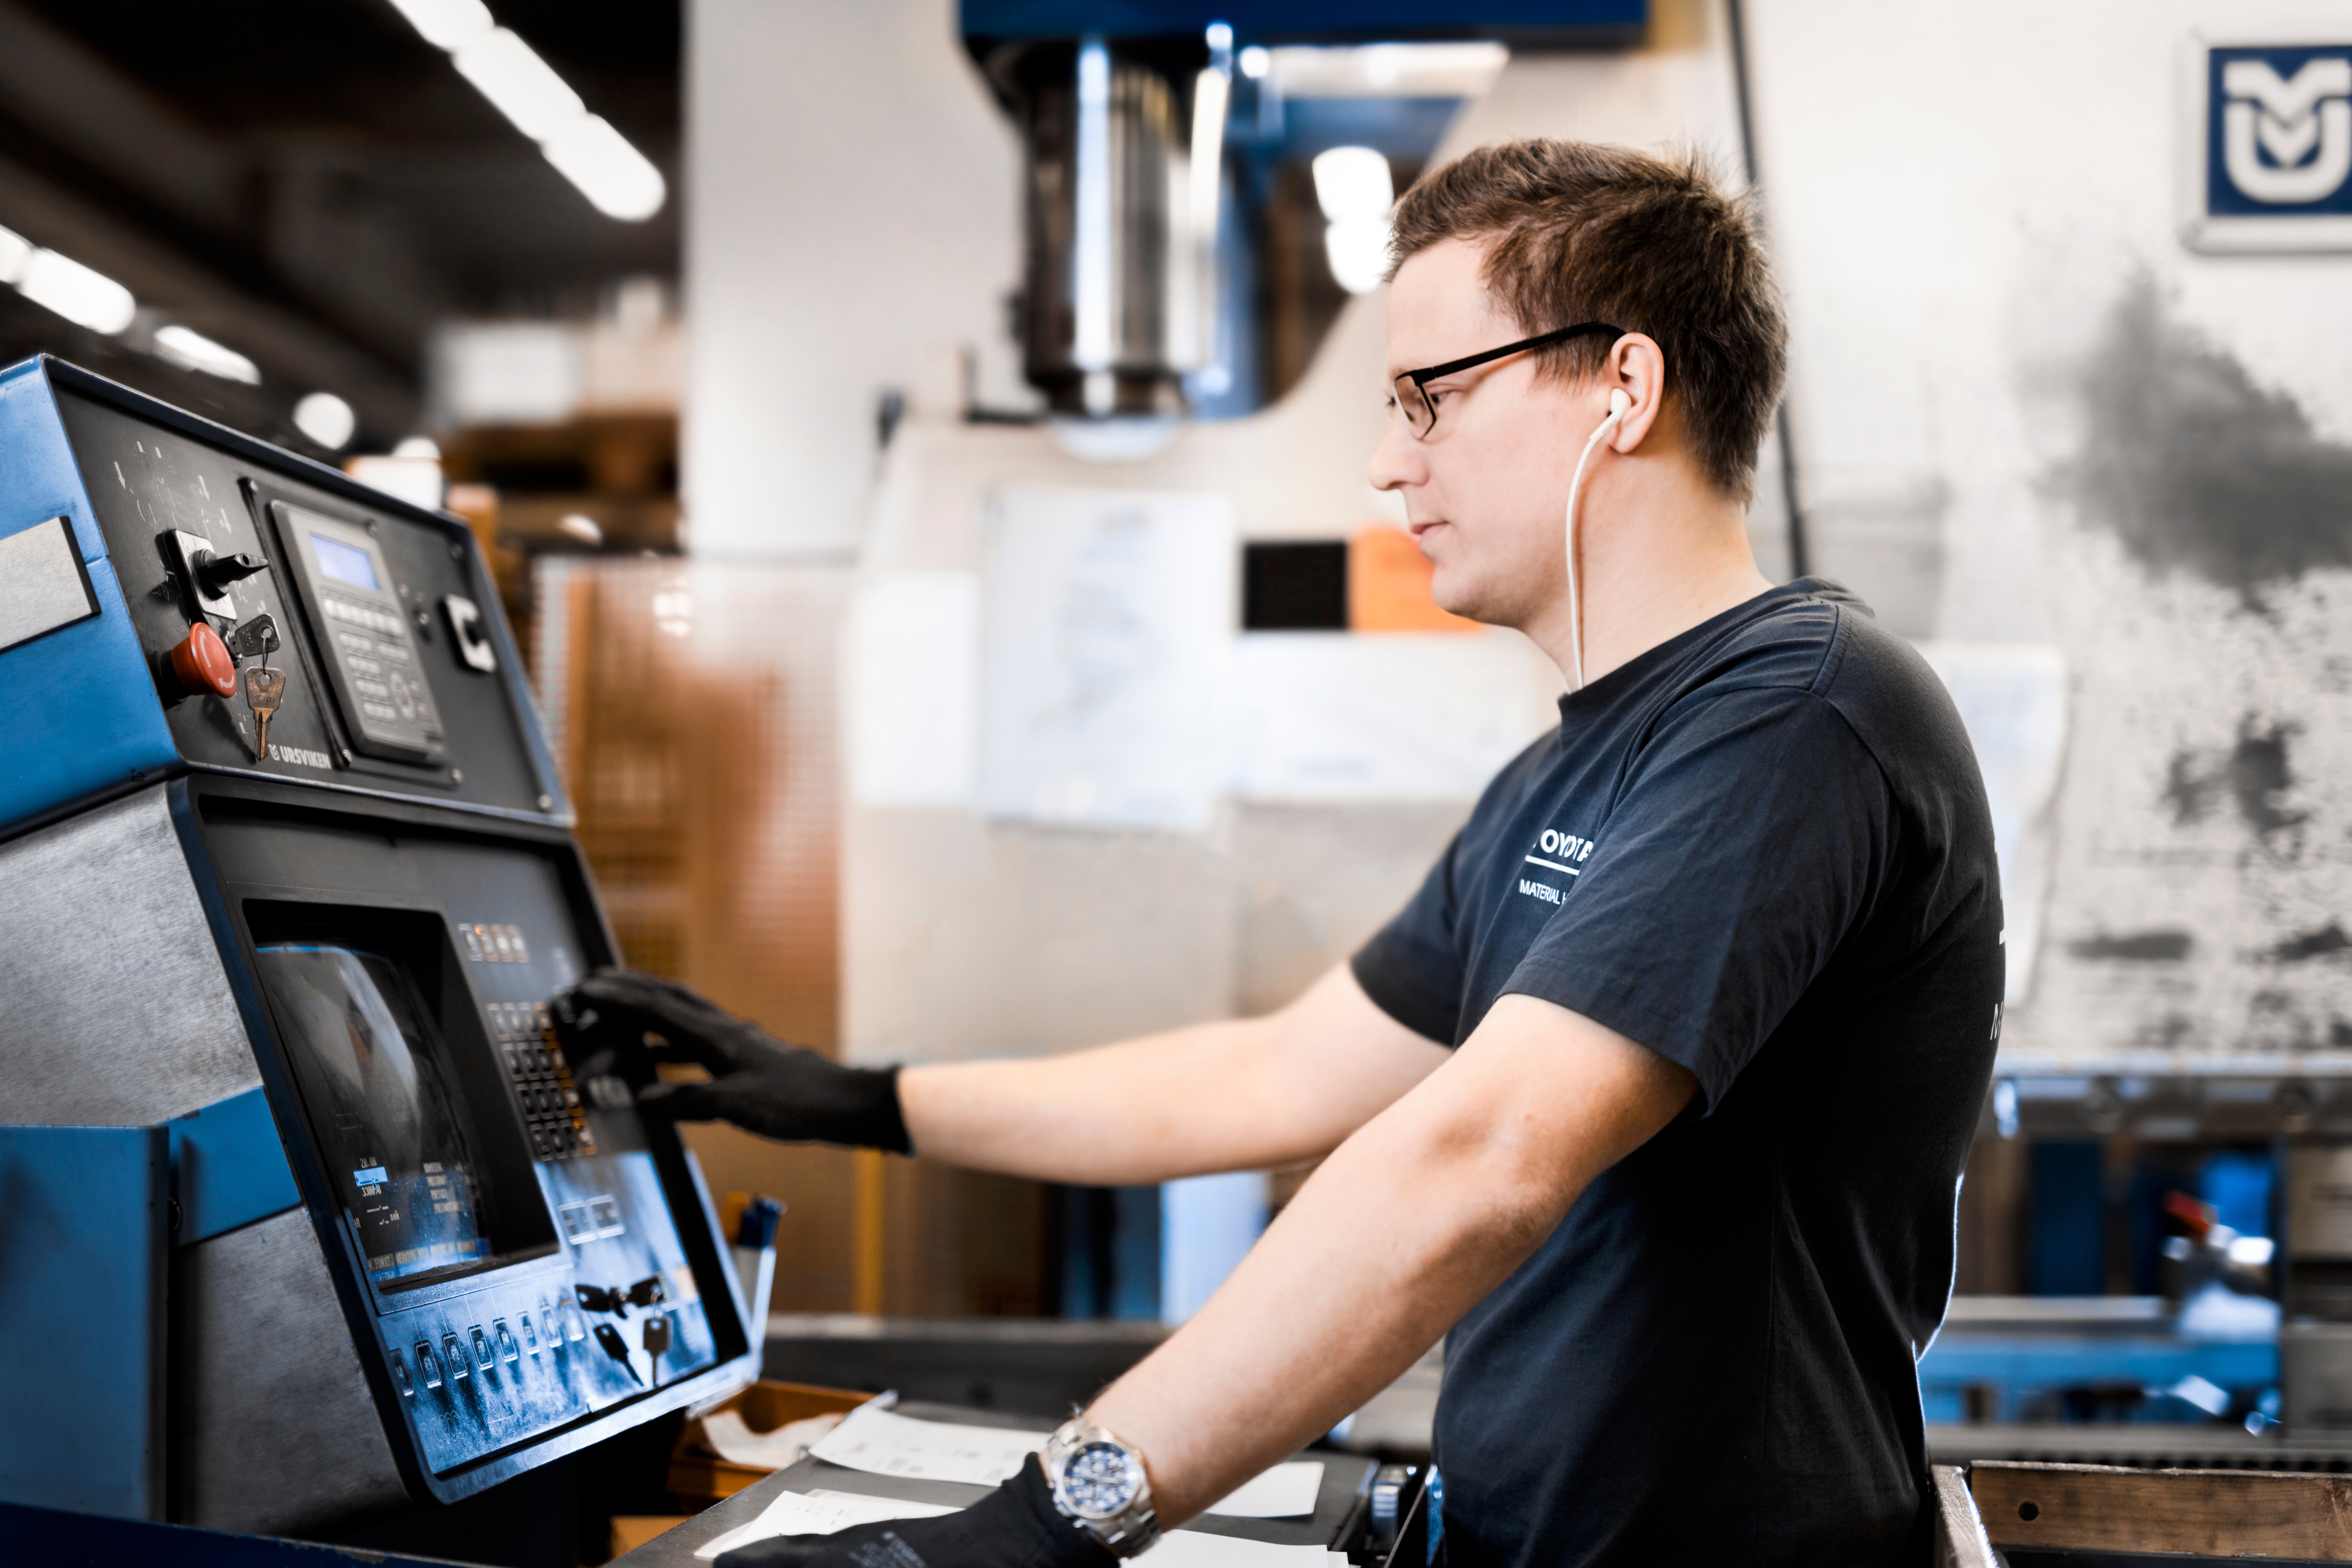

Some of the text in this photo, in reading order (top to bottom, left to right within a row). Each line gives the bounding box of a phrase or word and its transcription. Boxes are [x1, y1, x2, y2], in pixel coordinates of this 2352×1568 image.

[280, 745, 332, 770] URSVIKEN
[1533, 829, 1593, 862] OYOTA
[1519, 878, 1560, 905] MATERIAL
[360, 1156, 377, 1168] 20.00
